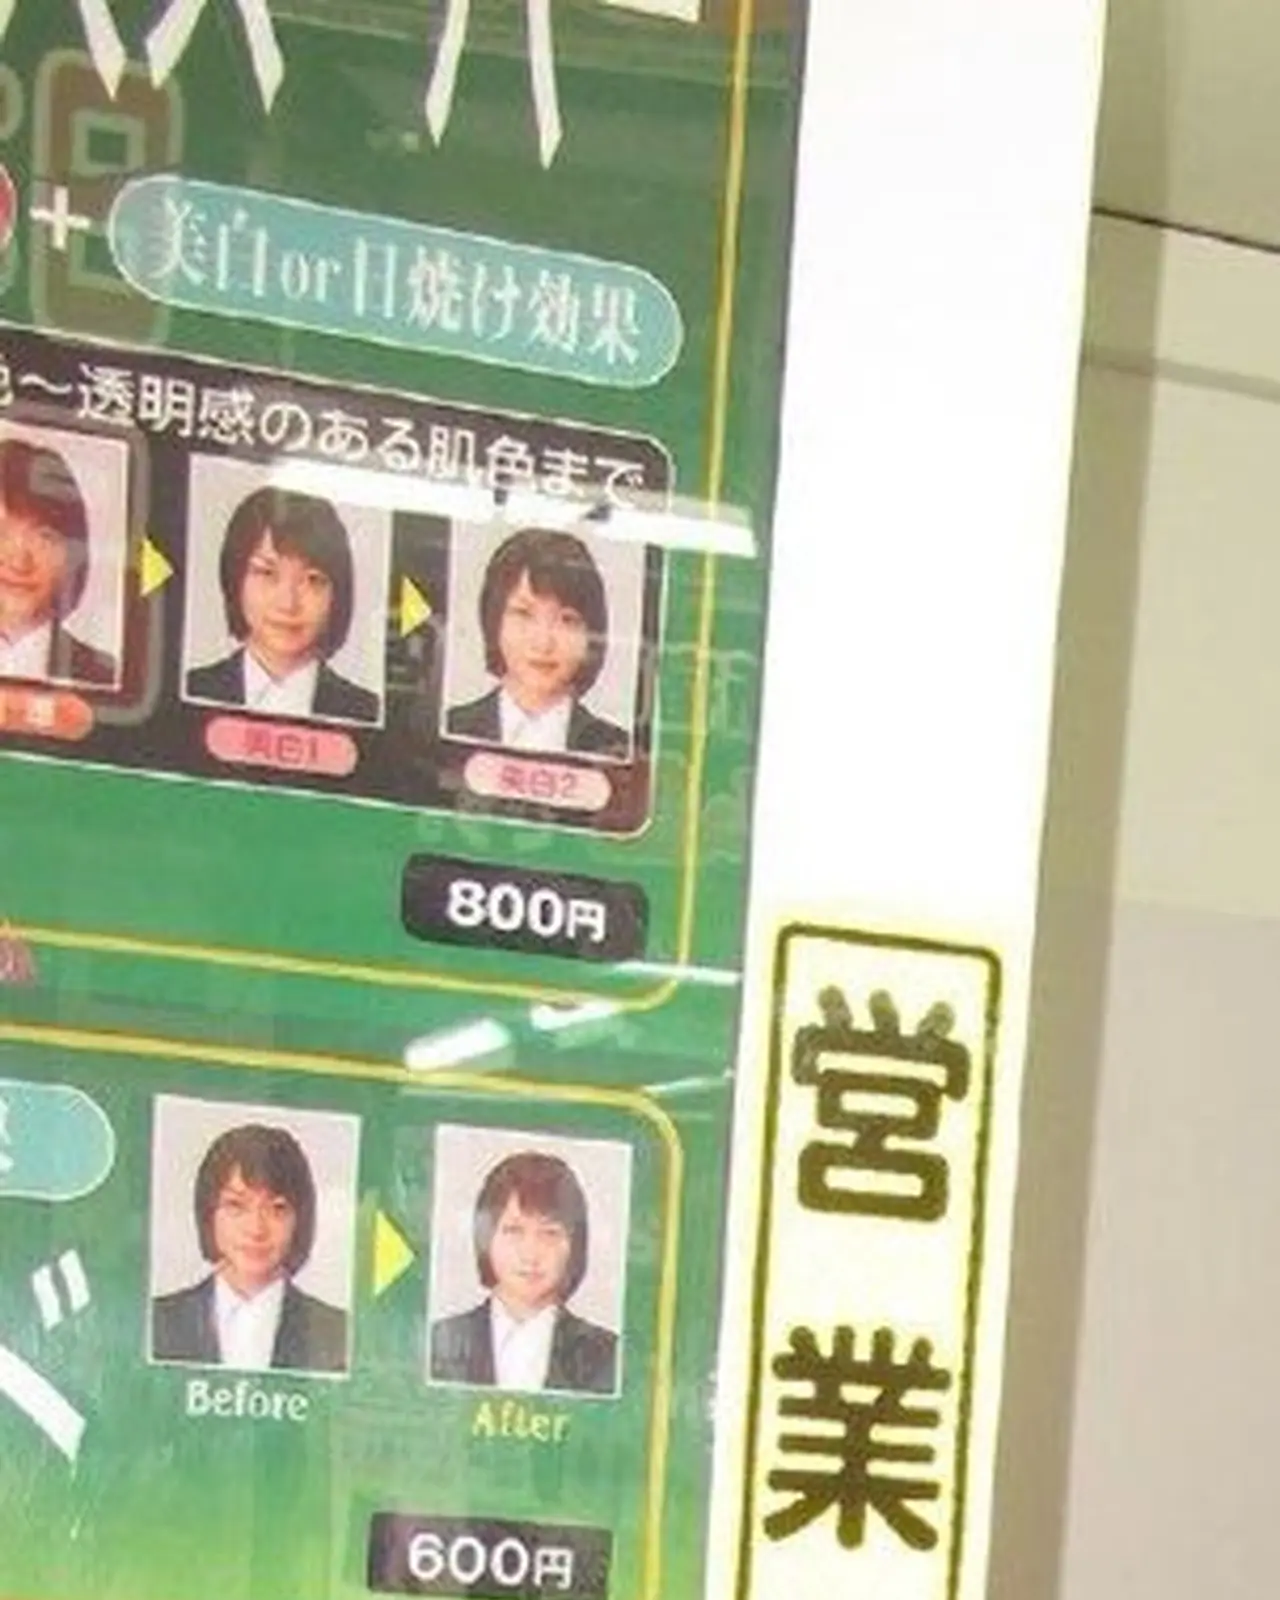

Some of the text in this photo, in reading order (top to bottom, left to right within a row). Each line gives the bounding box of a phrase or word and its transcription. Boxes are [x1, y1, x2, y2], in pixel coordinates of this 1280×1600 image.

[150, 196, 642, 366] 美白or日焼け効果
[0, 362, 645, 508] 〜透明感のある肌色まで
[445, 879, 606, 943] 800円
[186, 1379, 309, 1423] Before
[471, 1403, 571, 1443] After
[405, 1530, 576, 1591] 600円
